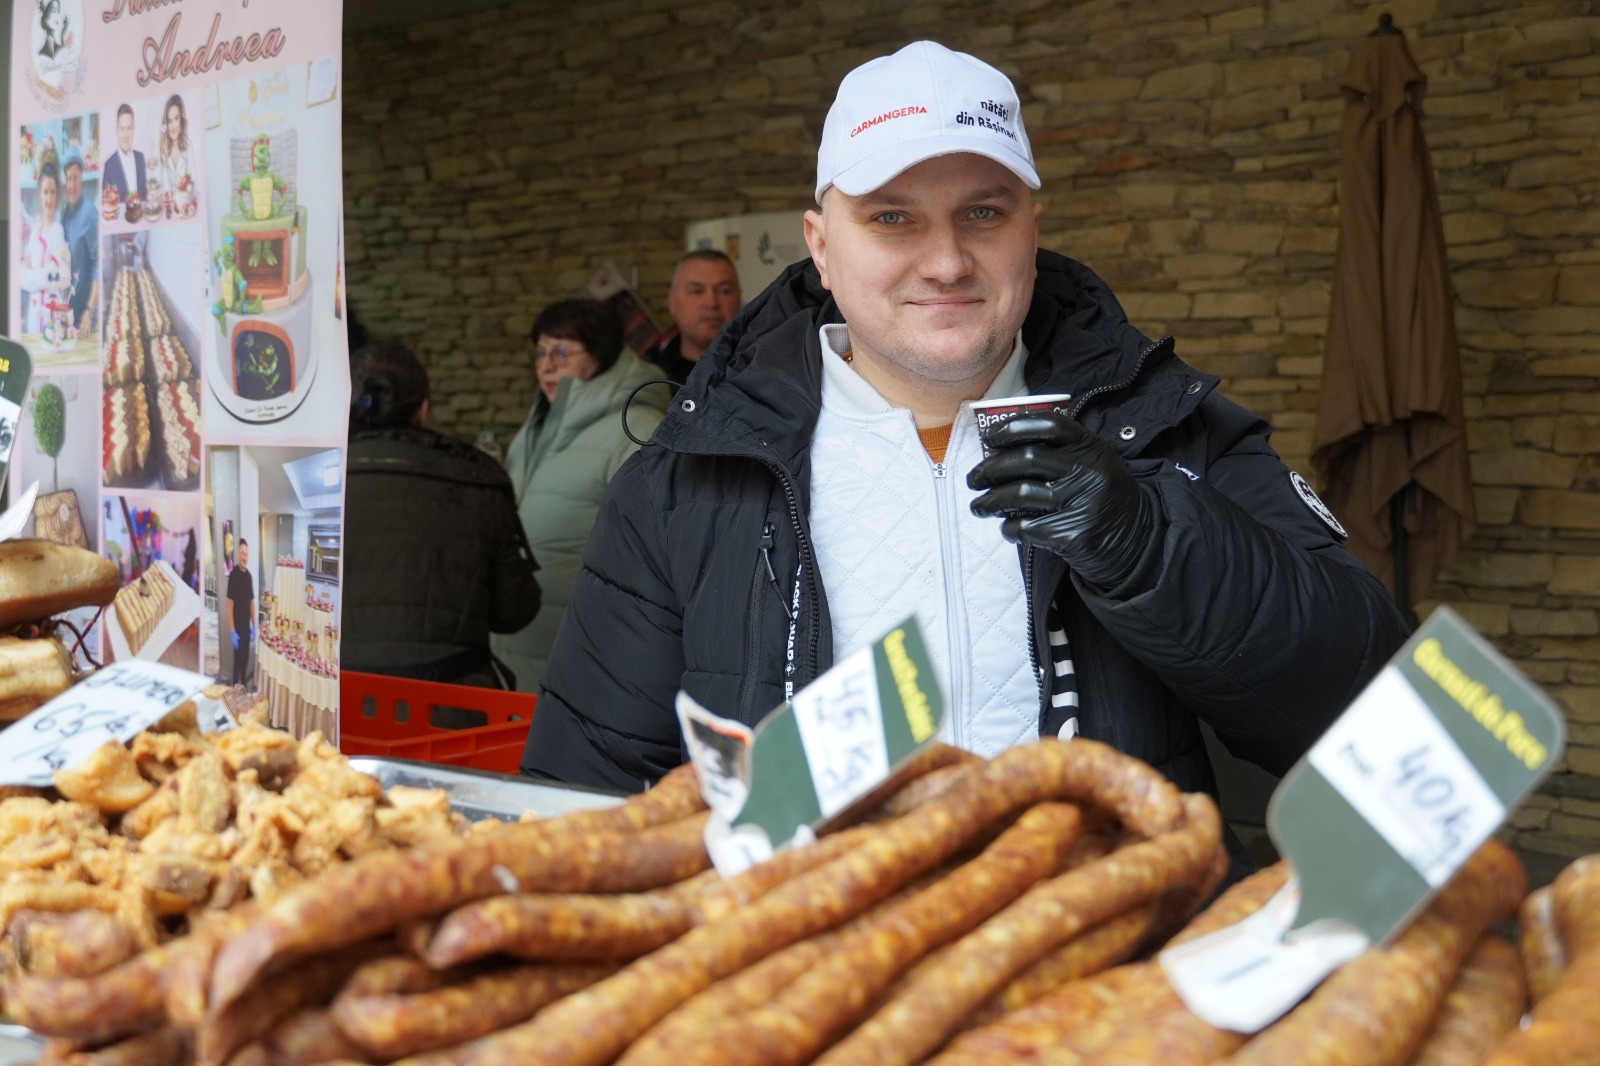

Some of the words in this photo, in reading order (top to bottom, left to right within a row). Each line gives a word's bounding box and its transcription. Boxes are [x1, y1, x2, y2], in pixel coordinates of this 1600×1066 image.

[137, 12, 286, 87] Andreea
[850, 105, 928, 138] CARMANGERIA
[956, 111, 975, 126] din
